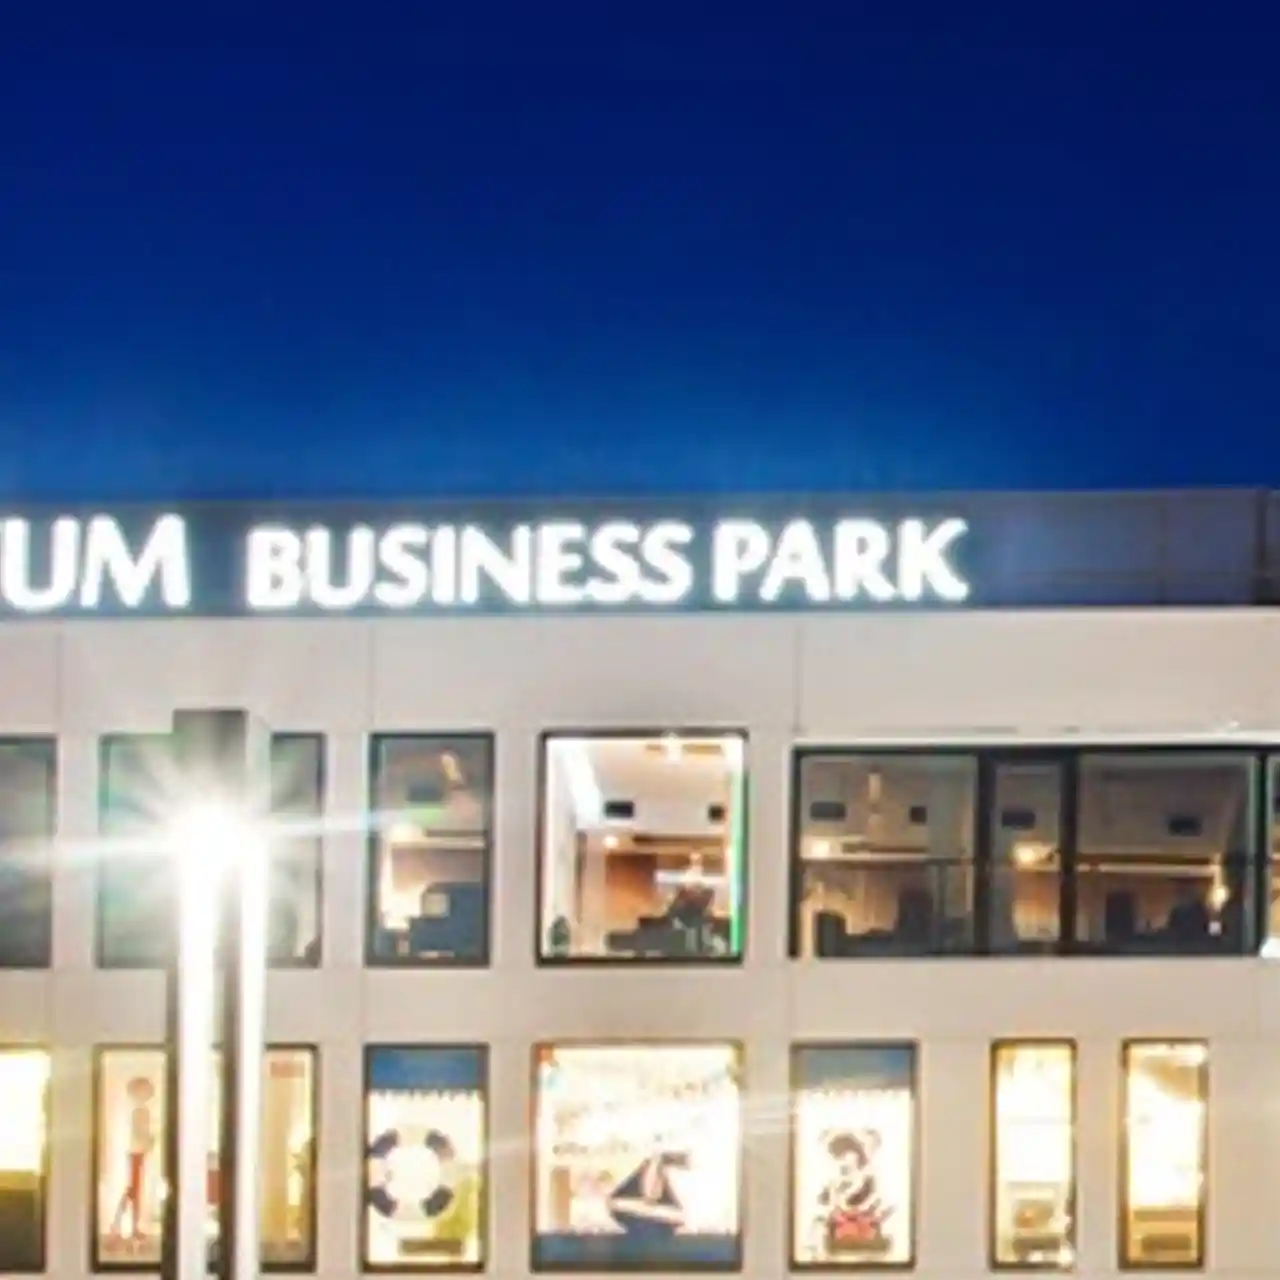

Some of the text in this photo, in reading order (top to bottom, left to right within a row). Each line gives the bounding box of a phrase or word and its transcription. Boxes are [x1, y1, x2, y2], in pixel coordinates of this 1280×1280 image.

[1, 513, 969, 611] UM BUSINESS PARK
